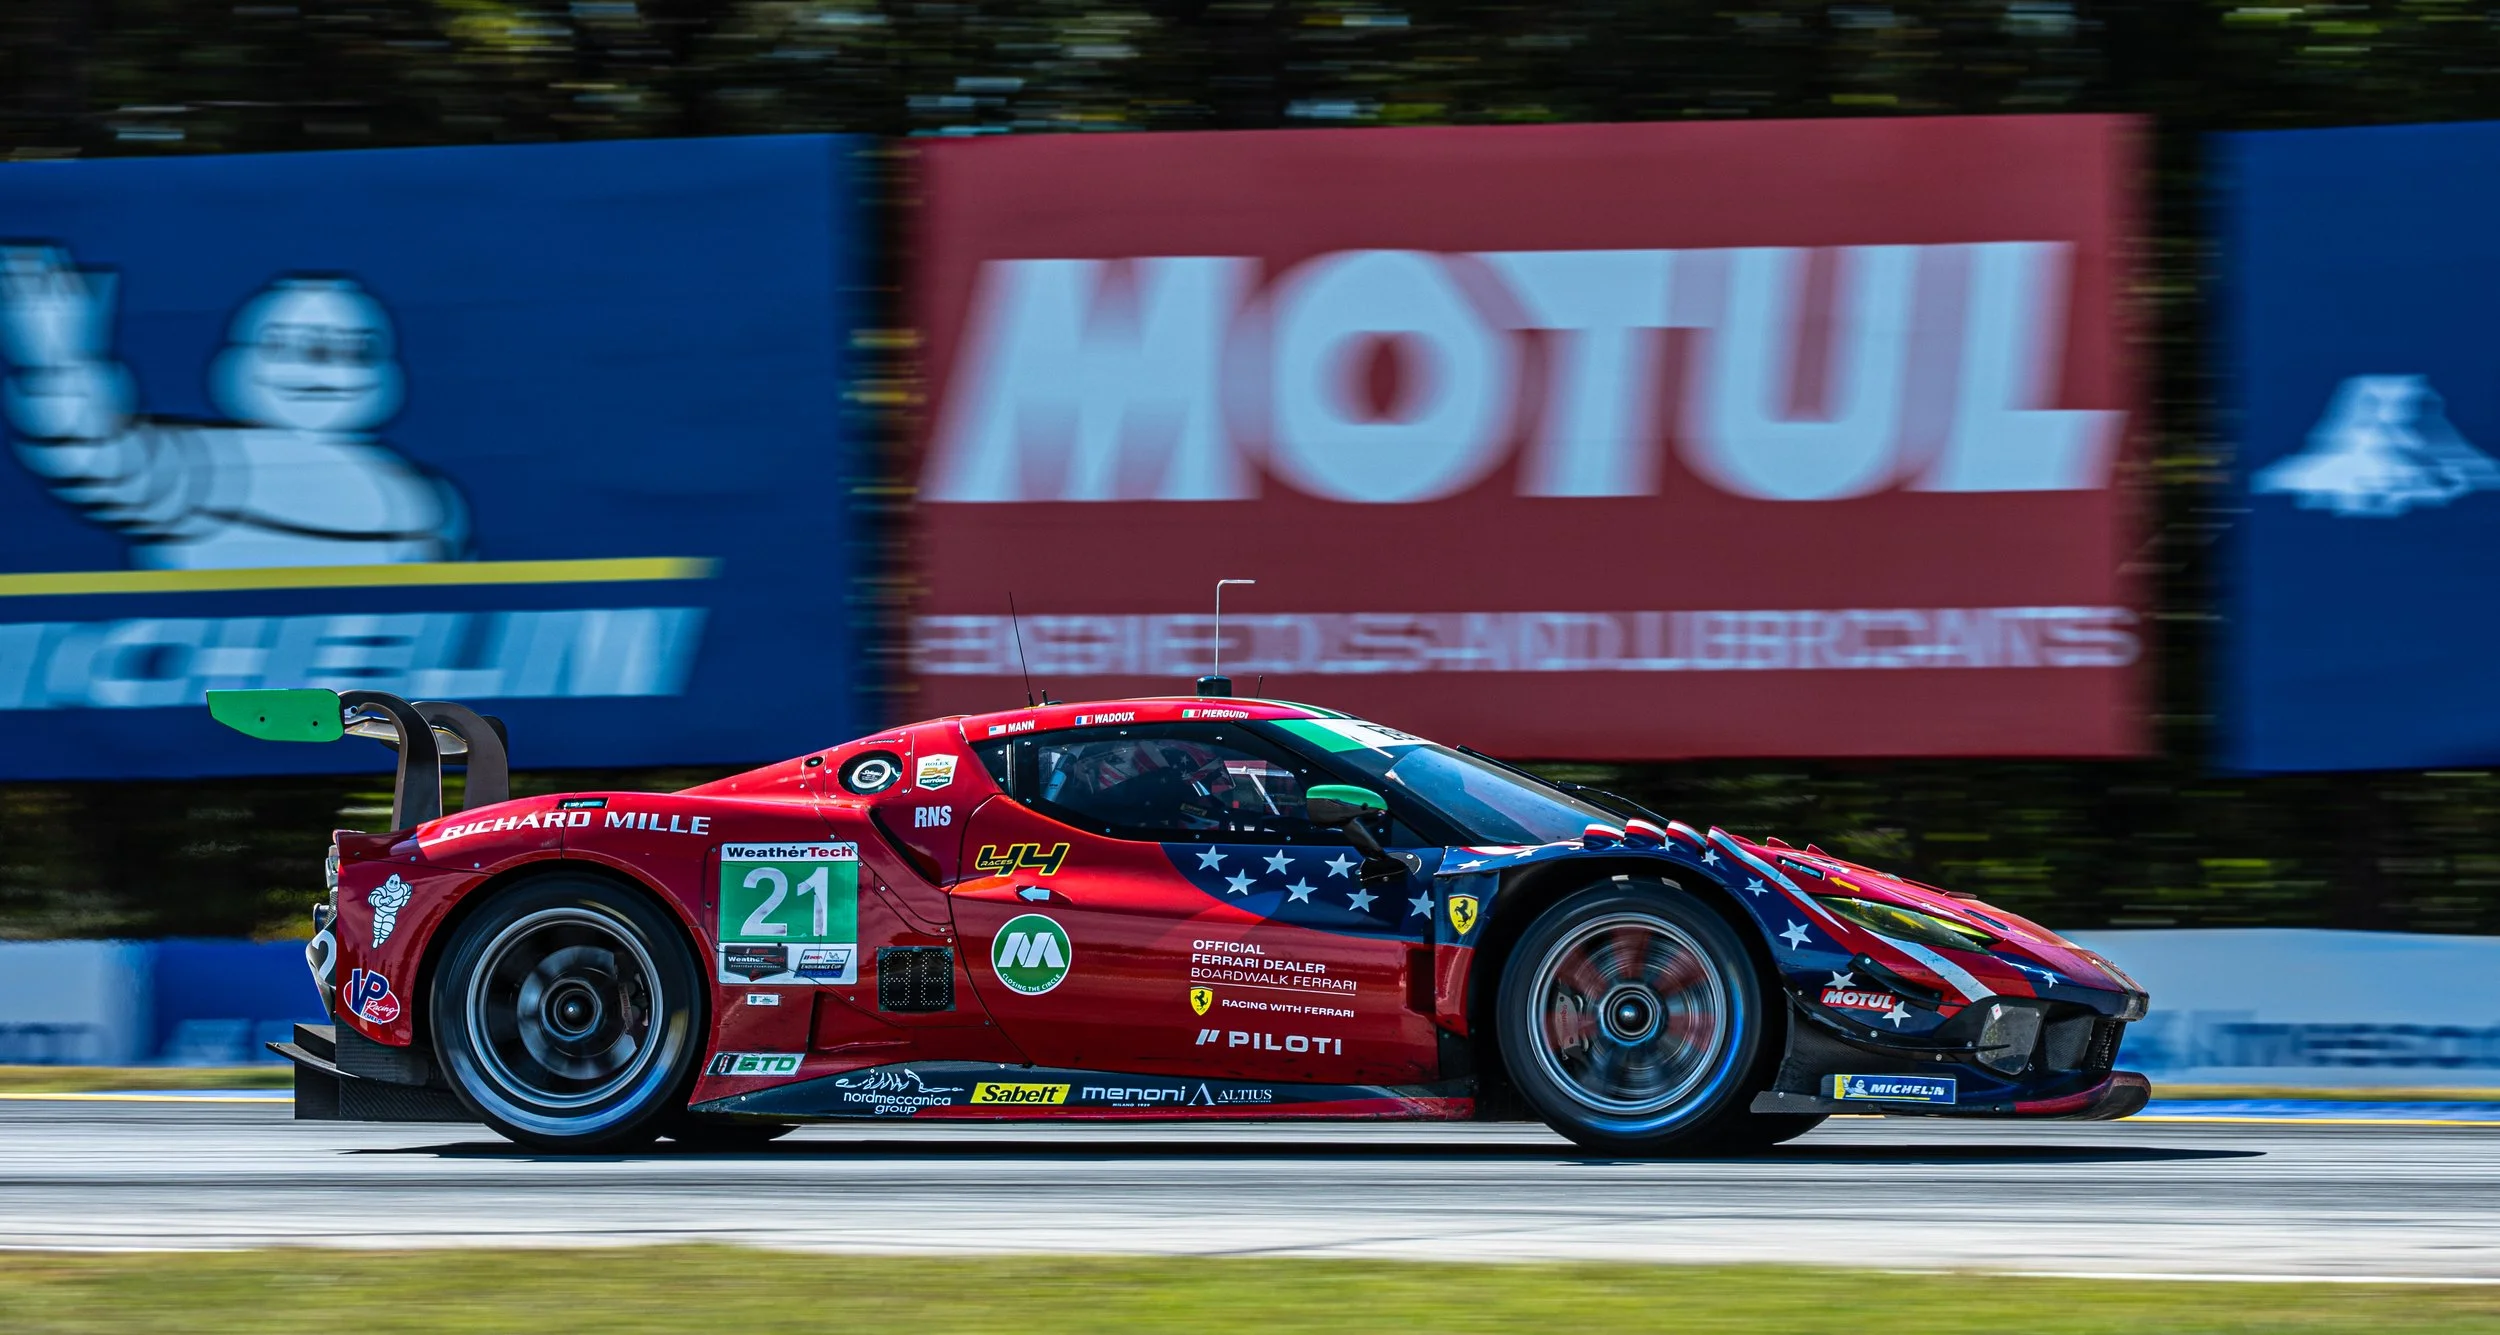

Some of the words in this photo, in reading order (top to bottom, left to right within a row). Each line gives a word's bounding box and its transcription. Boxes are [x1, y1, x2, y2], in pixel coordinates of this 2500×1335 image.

[920, 240, 2128, 503] MOTUL
[1094, 711, 1135, 724] WADOUX
[1201, 709, 1249, 719] PIERGUIDI
[1007, 719, 1035, 733] MANN
[920, 766, 952, 777] 24
[921, 776, 949, 784] DAYTONA
[914, 805, 952, 828] RNS
[438, 811, 591, 841] RICHARD
[604, 811, 711, 836] MILLE
[726, 845, 853, 858] WeatherTech
[980, 859, 1013, 867] RACES
[740, 866, 829, 937] 21
[1193, 939, 1265, 955] OFFICIAL
[1191, 953, 1259, 969] FERRARI
[1263, 959, 1326, 974] DEALER
[1002, 973, 1027, 991] CLOSING
[1041, 973, 1061, 990] CIRCLE
[1190, 967, 1289, 985] BOARDWALK
[1293, 975, 1357, 991] FERRARI
[351, 968, 390, 1017] VP
[1822, 990, 1893, 1009] MOTUL
[364, 1000, 396, 1018] Racing
[1222, 999, 1267, 1011] RACING
[1270, 1003, 1301, 1014] WITH
[1304, 1006, 1354, 1018] FERRARI
[1228, 1030, 1342, 1055] PILOTI
[737, 1056, 797, 1072] GTD
[981, 1084, 1060, 1102] Sabelt
[1081, 1086, 1186, 1101] menoni
[1217, 1089, 1272, 1100] ALTIUS
[1869, 1083, 1945, 1096] MICHELIN
[843, 1090, 951, 1106] nordmeccanica
[874, 1105, 917, 1115] group
